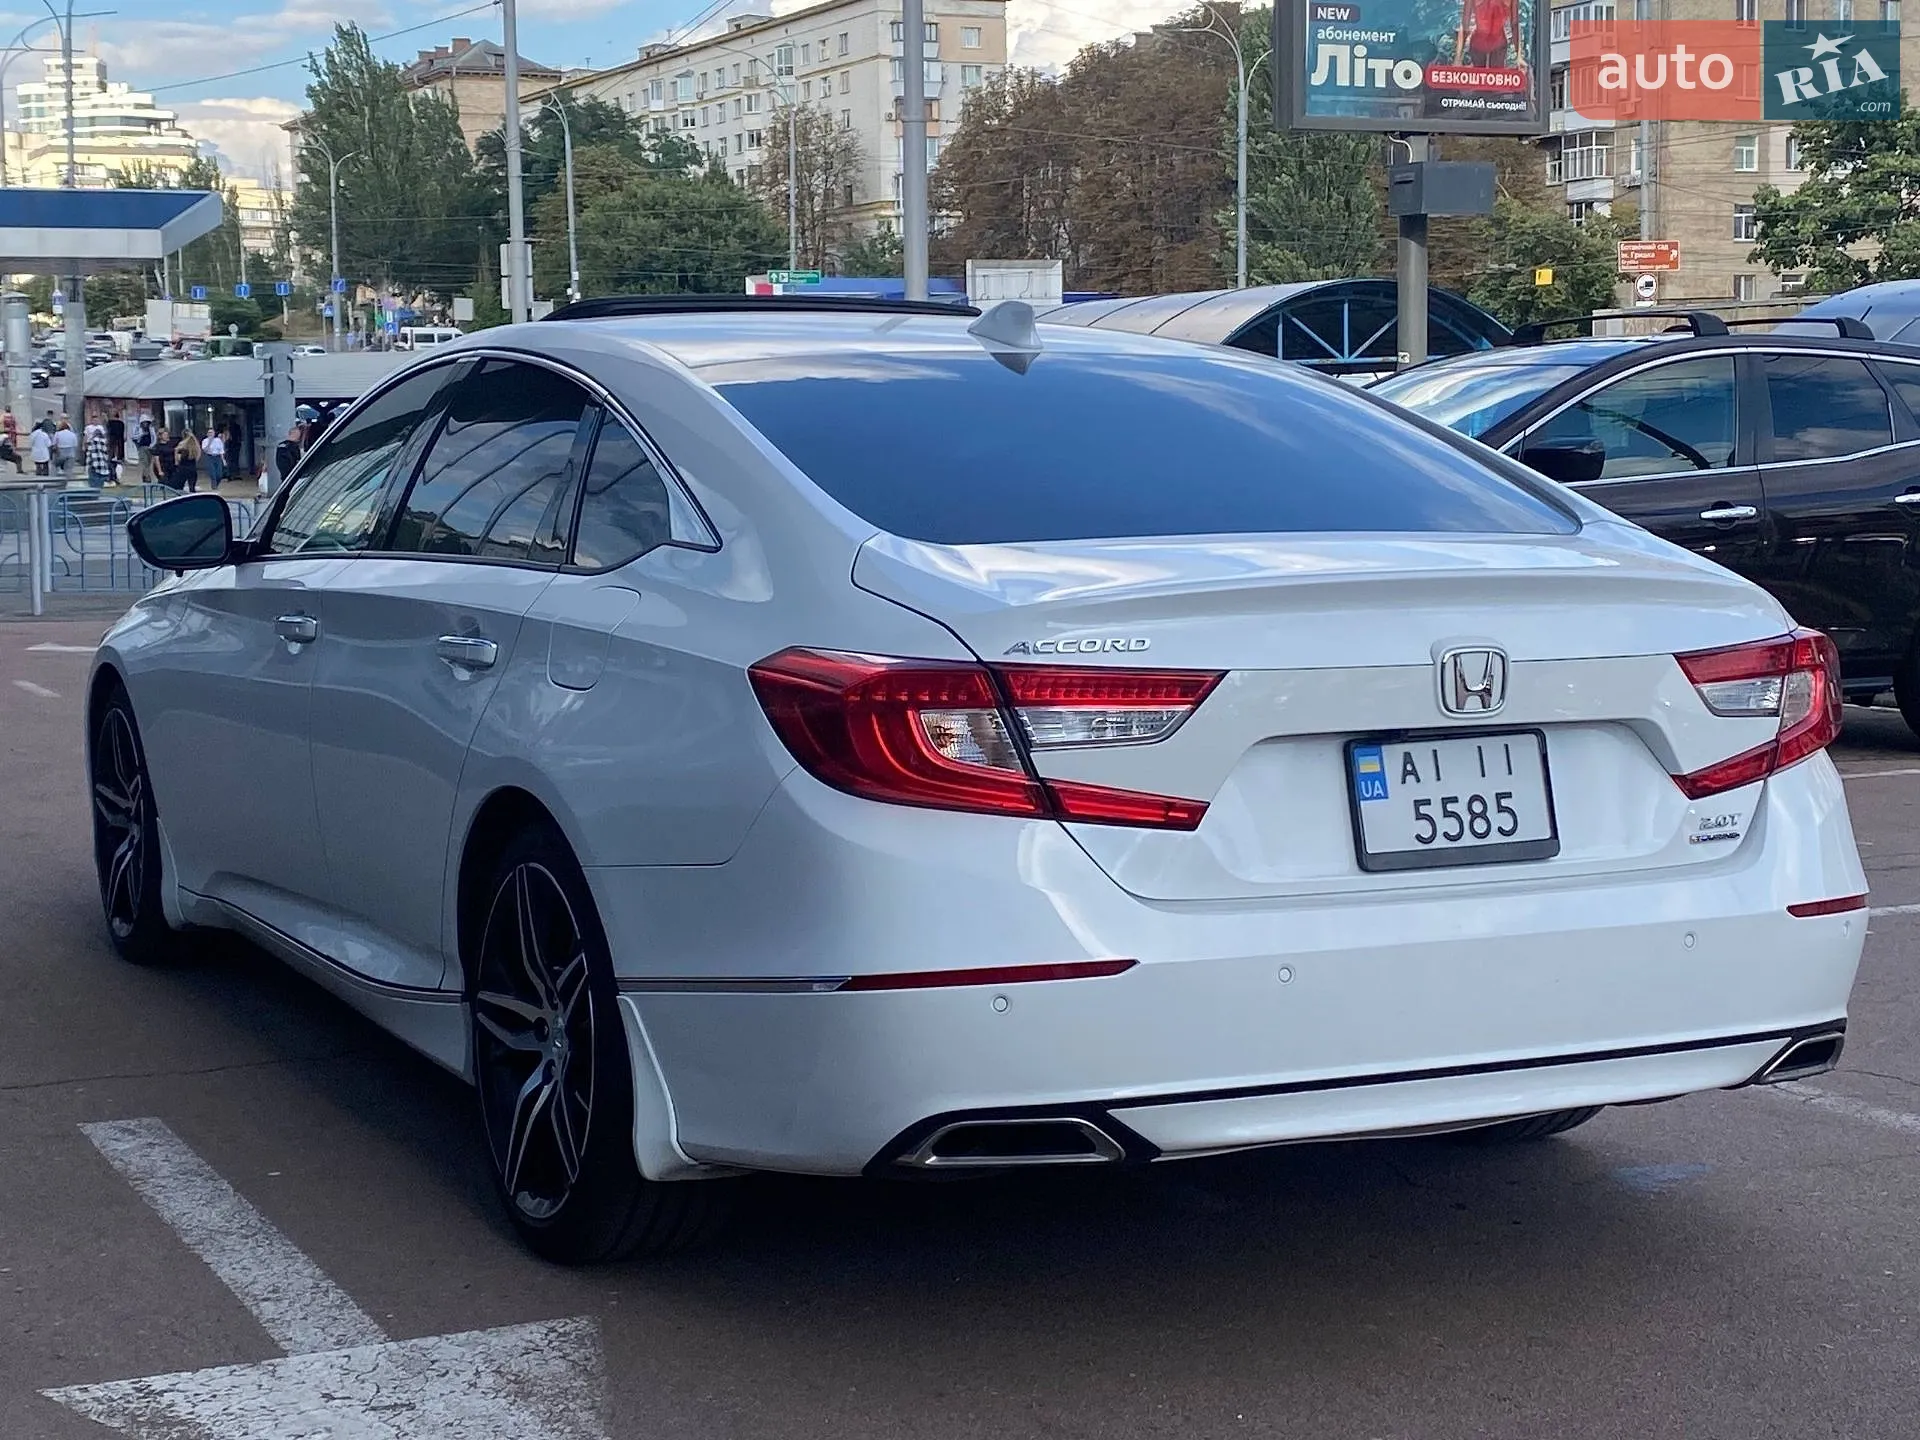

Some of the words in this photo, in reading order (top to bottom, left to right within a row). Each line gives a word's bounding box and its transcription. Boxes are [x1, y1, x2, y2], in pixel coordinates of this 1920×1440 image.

[1316, 7, 1350, 21] NEW
[1316, 26, 1396, 43] абонемент
[1310, 44, 1424, 90] Літо
[1431, 70, 1521, 87] БЕЗКОШТОВНО
[1441, 98, 1485, 109] ОТРИМАЙ
[1002, 637, 1152, 656] ACCORD
[1401, 748, 1442, 785] AI
[1360, 779, 1385, 799] UA
[1412, 791, 1519, 845] 5585
